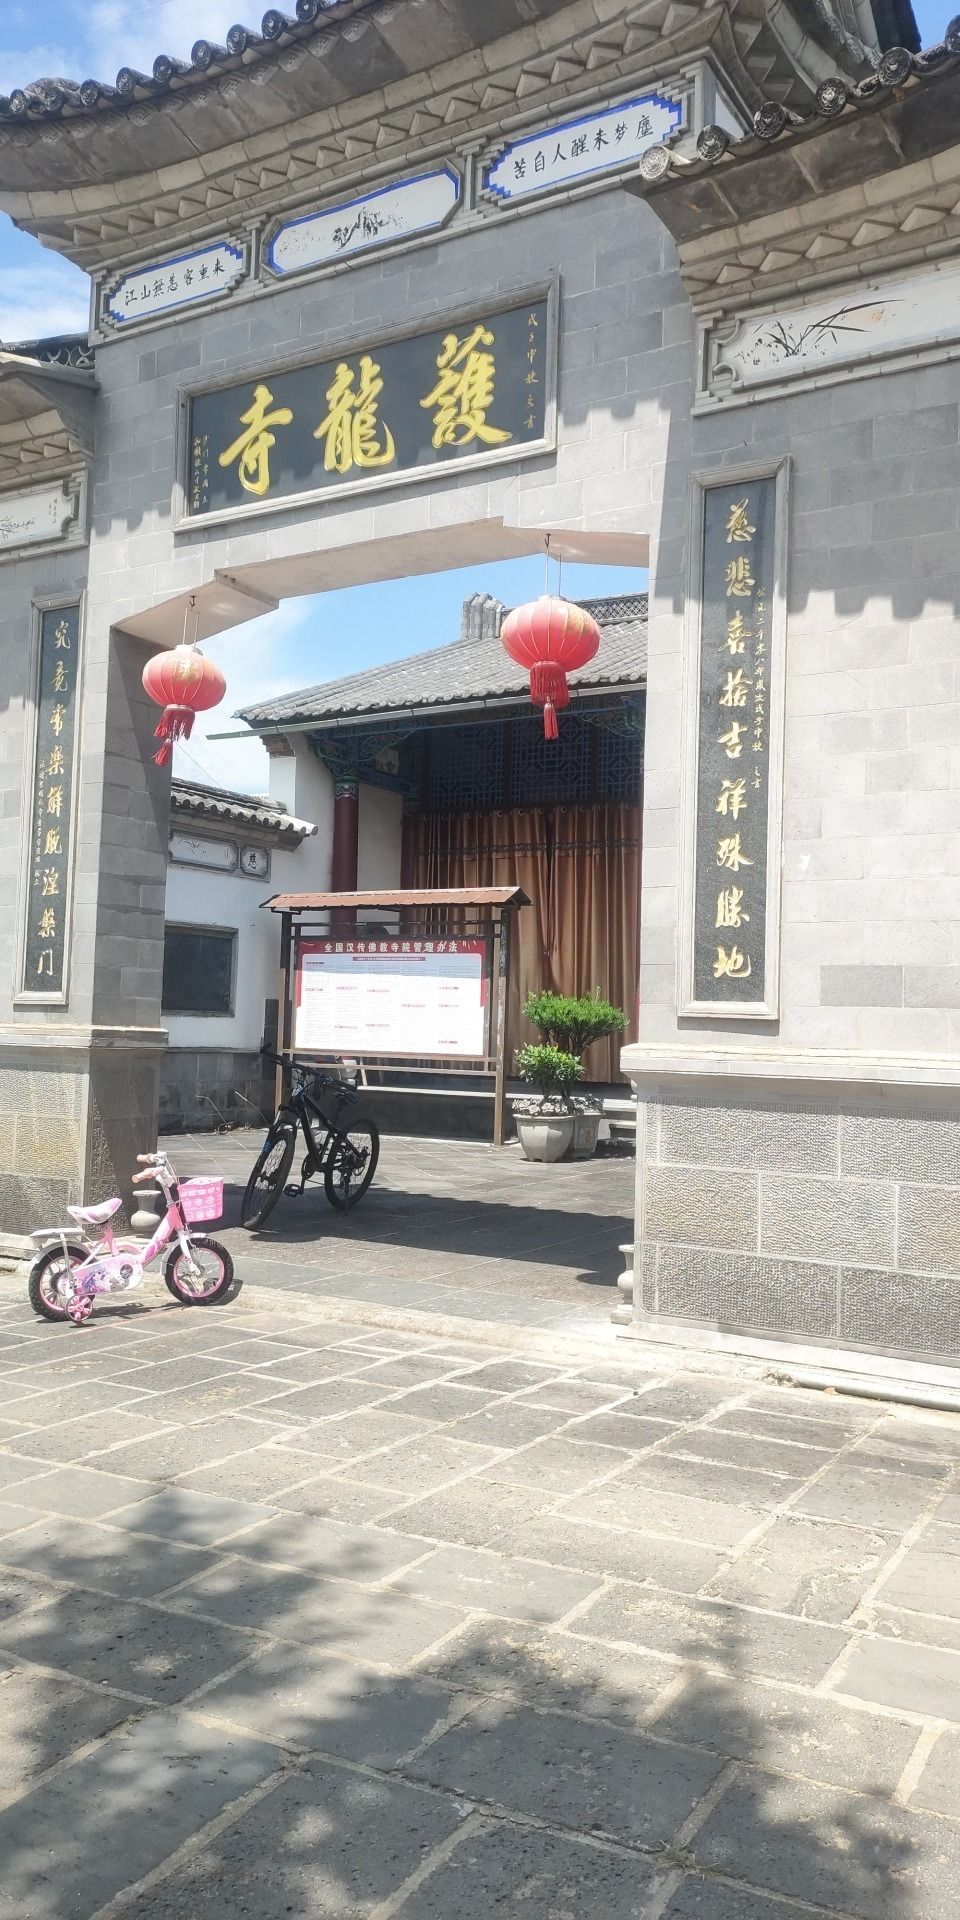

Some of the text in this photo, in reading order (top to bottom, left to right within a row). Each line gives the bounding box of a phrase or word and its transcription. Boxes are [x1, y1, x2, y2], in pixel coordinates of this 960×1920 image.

[324, 940, 458, 954] 全国汉传佛教寺院管理办法
